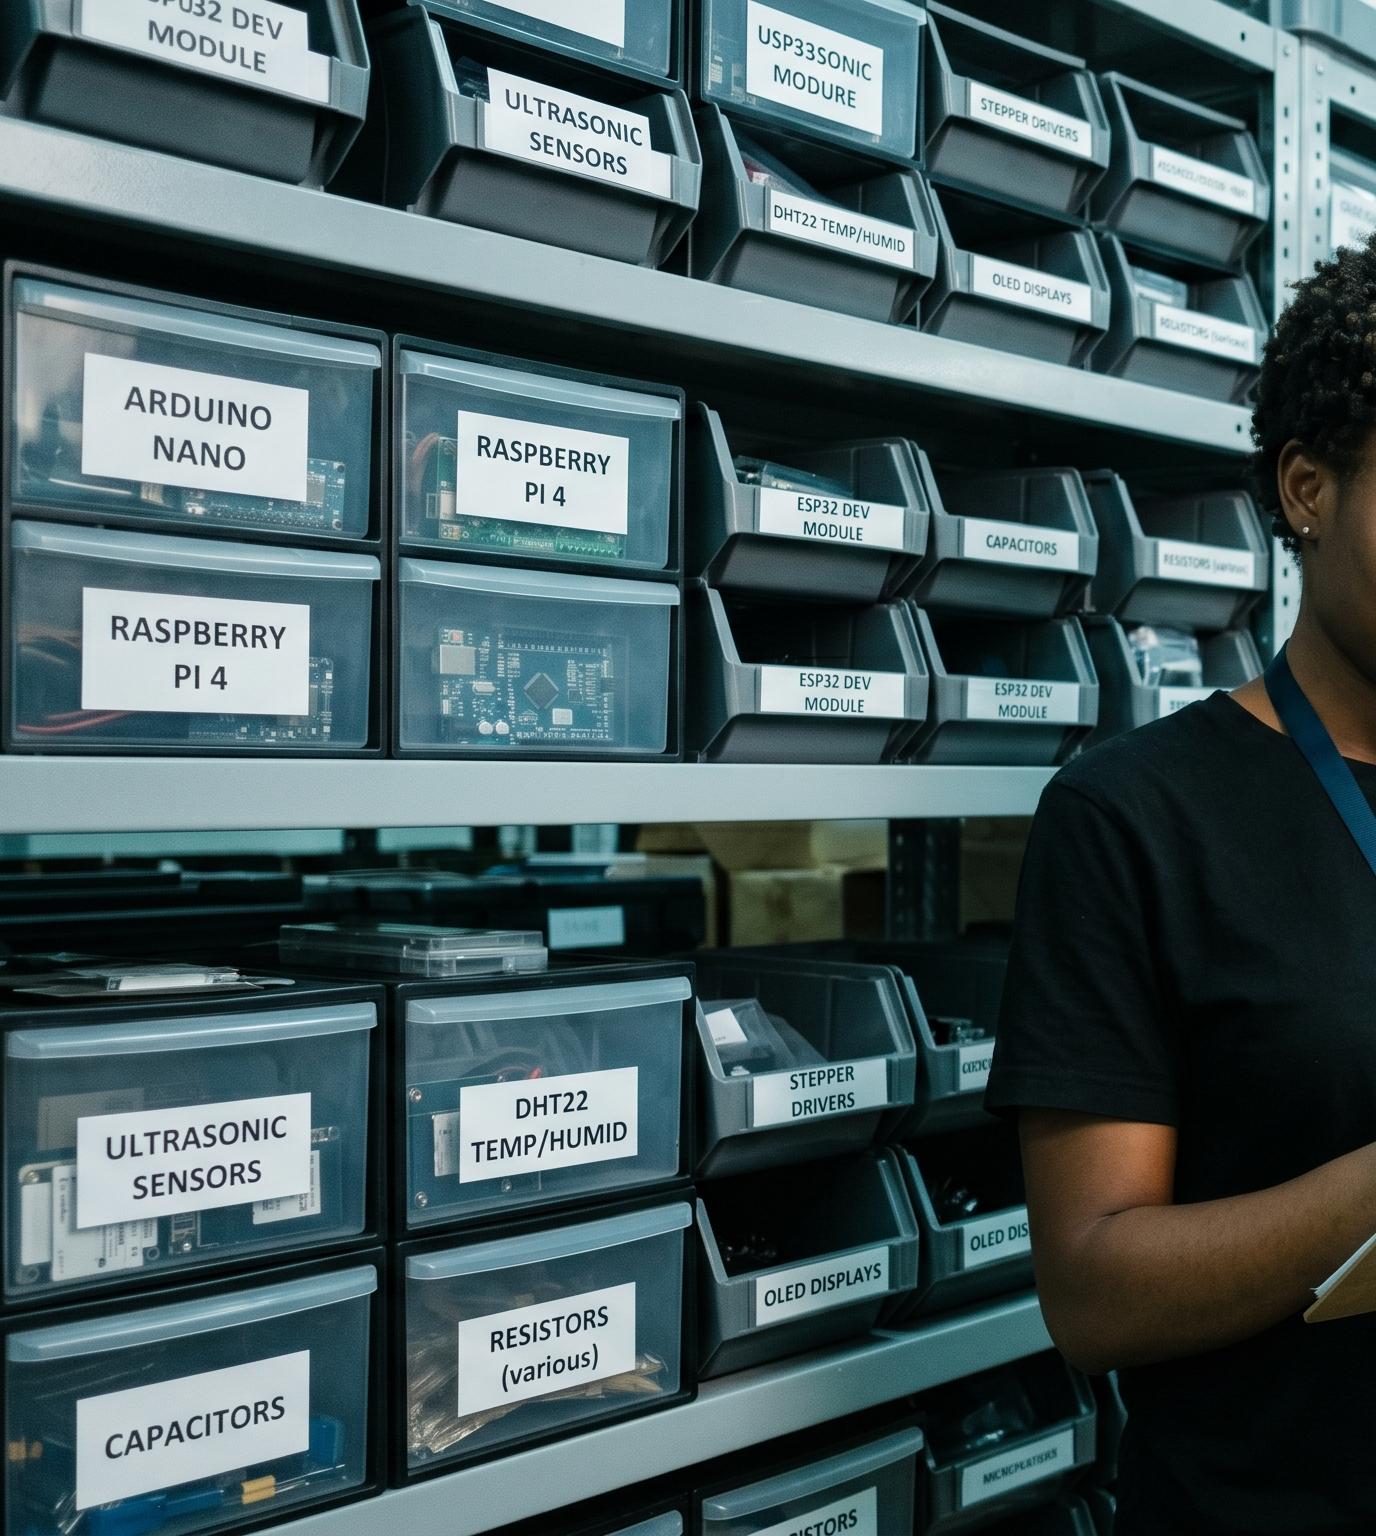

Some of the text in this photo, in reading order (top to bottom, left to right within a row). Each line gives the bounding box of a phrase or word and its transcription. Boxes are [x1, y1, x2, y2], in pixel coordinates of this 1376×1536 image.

[232, 6, 284, 40] DEV
[148, 19, 267, 74] MODULE
[758, 24, 872, 81] USP33SONIC
[773, 64, 856, 109] MODURE
[505, 88, 643, 147] ULTRASONIC
[980, 97, 1079, 143] STEPPER DRIVERS
[529, 131, 628, 176] SENSORS
[774, 204, 906, 253] DHT22 TEMP/HUMID
[992, 273, 1072, 305] OLED DISPLAYS
[123, 386, 272, 431] ARDUINO
[153, 434, 246, 471] NANO
[476, 434, 611, 476] RASPBERRY
[524, 481, 567, 508] PI 4
[797, 496, 870, 519] ESP32 DEV
[802, 521, 864, 542] MODULE
[986, 534, 1058, 556] CAPACITORS
[111, 615, 287, 650] RASPBERRY
[174, 664, 229, 692] PI 4
[799, 672, 872, 691] ESP32 DEV
[994, 682, 1053, 698] ESP32 DEV
[804, 696, 865, 714] MODULE
[998, 704, 1049, 720] MODULE
[789, 1065, 855, 1091] STEPPER
[515, 1090, 589, 1120] DHT22
[791, 1091, 856, 1119] DRIVERS
[106, 1115, 287, 1160] ULTRASONIC
[470, 1121, 628, 1163] TEMP/HUMID
[132, 1159, 262, 1200] SENSORS
[970, 1229, 1005, 1252] OLED
[764, 1262, 882, 1307] OLED DISPLAYS
[490, 1305, 609, 1353] RESISTORS
[501, 1343, 599, 1393] (various)
[105, 1395, 285, 1460] CAPACITORS
[789, 1508, 858, 1536] STORS
